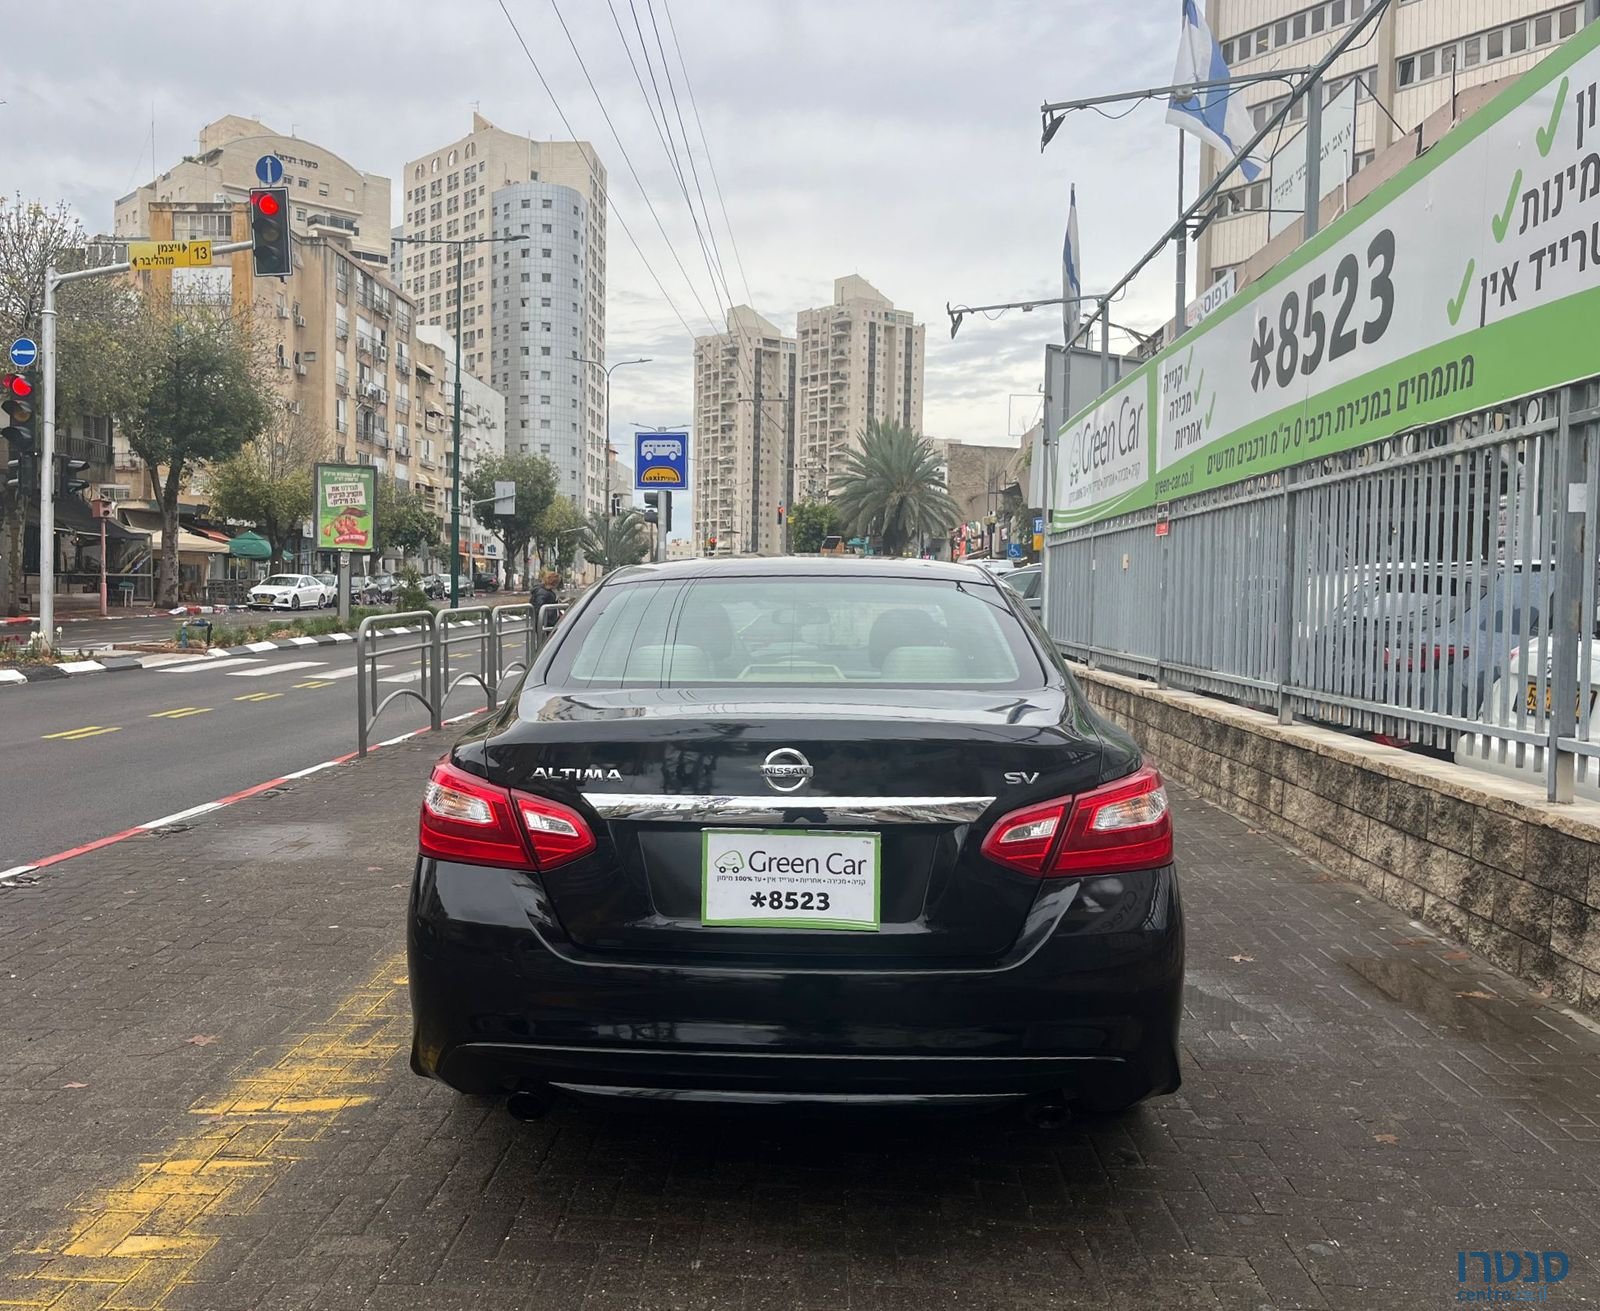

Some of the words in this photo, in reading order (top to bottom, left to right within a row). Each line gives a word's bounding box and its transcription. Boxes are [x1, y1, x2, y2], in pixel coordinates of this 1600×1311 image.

[139, 254, 175, 266] מוהליבר
[157, 244, 180, 255] ויצמן
[193, 246, 208, 260] 13
[1204, 280, 1229, 314] דפוס
[1480, 260, 1520, 328] אין
[1163, 364, 1183, 395] קנייה
[1396, 354, 1475, 412] מתמחים
[1168, 391, 1192, 422] מכירה
[1333, 387, 1392, 434] במכירת
[1082, 422, 1116, 475] Green
[1118, 395, 1144, 456] Car
[1174, 418, 1203, 451] אחריות
[1293, 417, 1301, 448] 0
[1304, 411, 1332, 443] רכבי
[1206, 446, 1235, 475] חדשים
[1237, 436, 1267, 465] ורכבים
[530, 767, 624, 782] ALTIMA
[763, 767, 808, 776] NISSAN
[1003, 771, 1040, 784] SV
[748, 850, 819, 873] Green
[825, 852, 867, 875] Car
